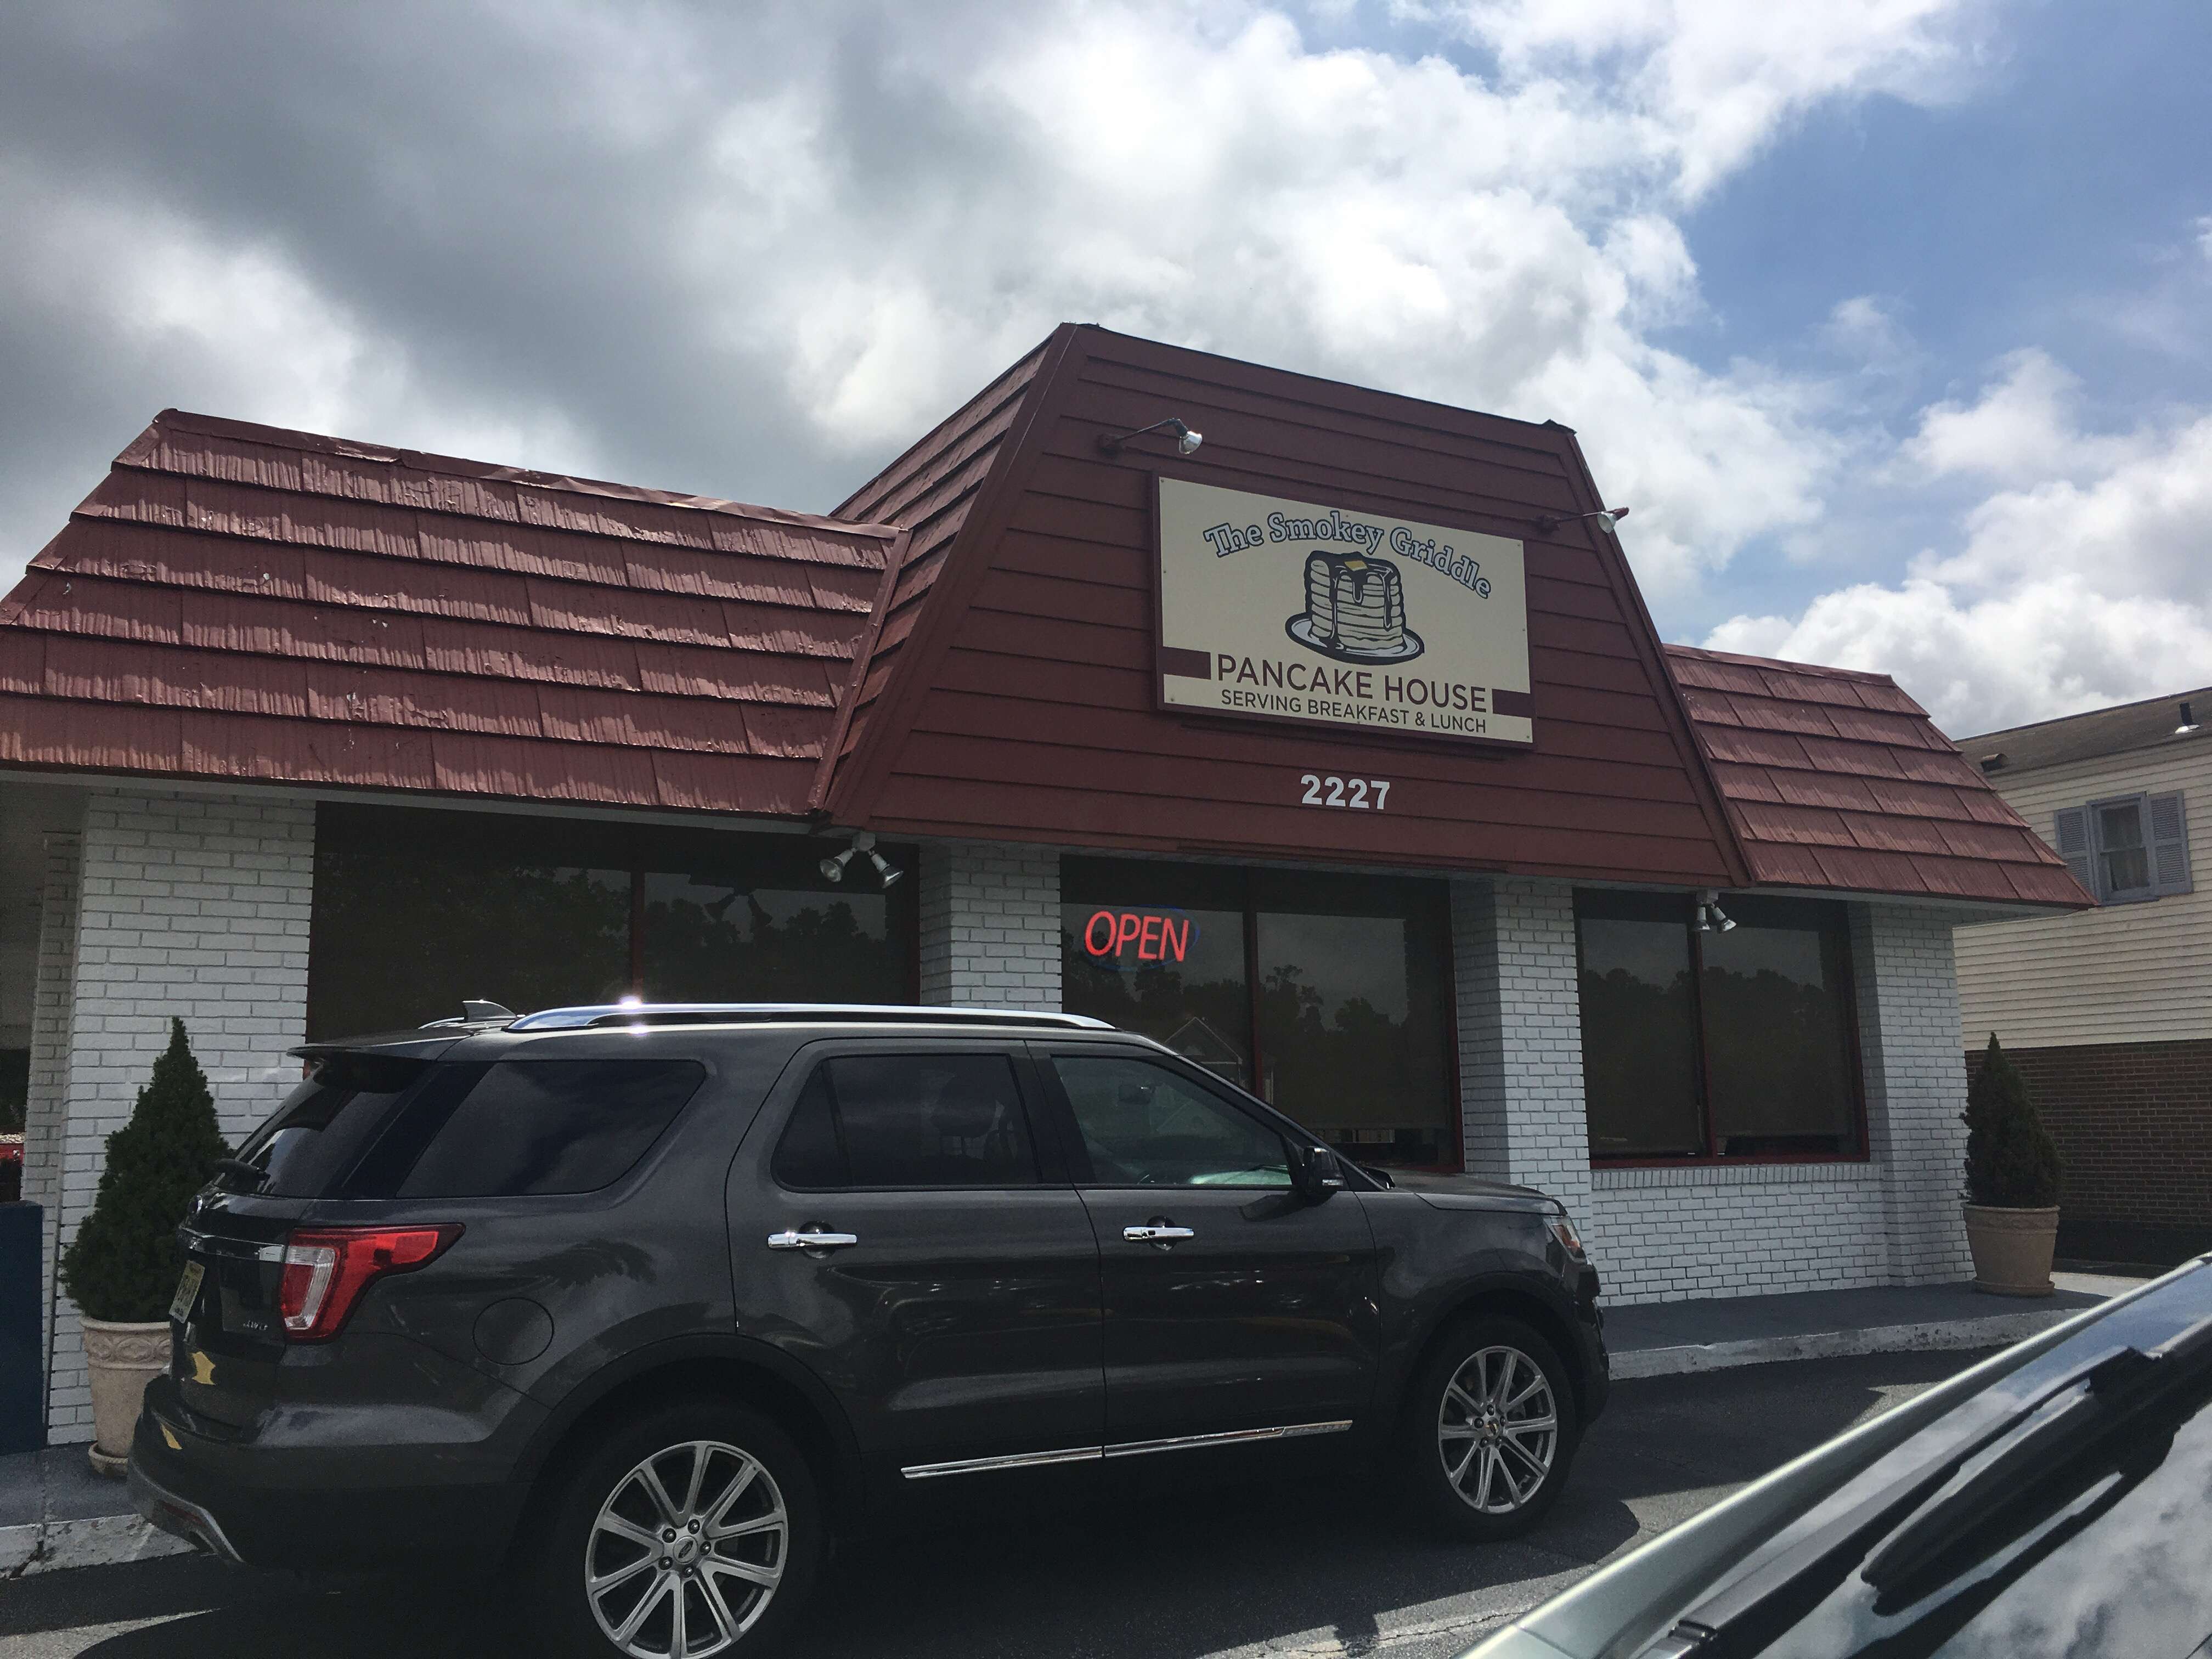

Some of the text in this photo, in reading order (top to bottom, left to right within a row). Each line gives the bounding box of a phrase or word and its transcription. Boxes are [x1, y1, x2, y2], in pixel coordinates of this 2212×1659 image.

[1204, 511, 1491, 599] The Smokey Griddle
[1218, 654, 1486, 713] PANCAKE HOUSE
[1221, 689, 1486, 733] SERVING BREAKFAST & LUNCH
[1301, 775, 1390, 810] 2227
[1085, 911, 1189, 962] OPEN
